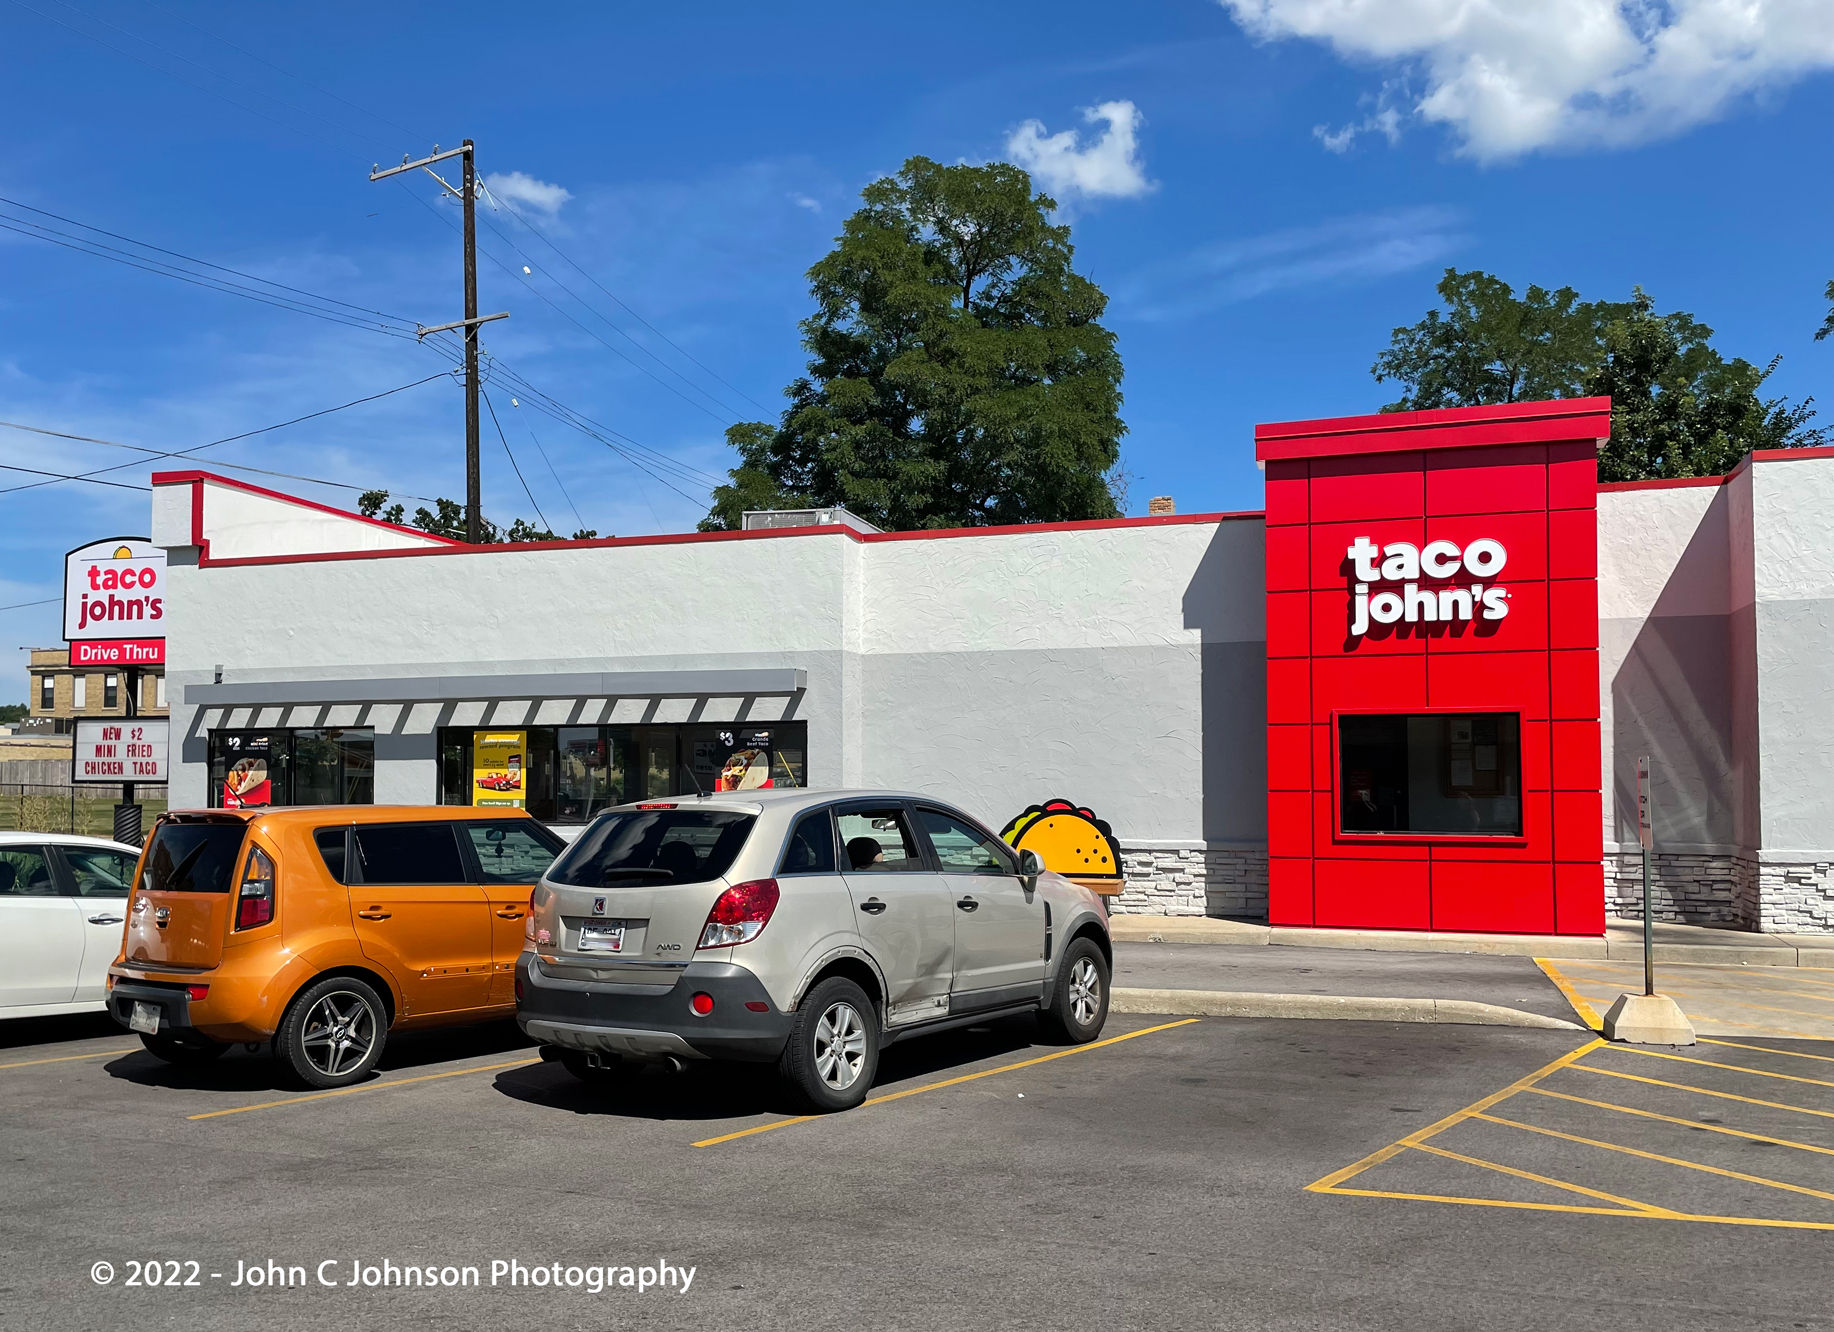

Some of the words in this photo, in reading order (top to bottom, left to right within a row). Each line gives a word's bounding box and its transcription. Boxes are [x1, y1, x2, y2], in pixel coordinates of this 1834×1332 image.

[1347, 536, 1507, 582] taco
[87, 564, 157, 591] taco
[78, 593, 163, 630] john's
[1351, 582, 1510, 636] john's
[80, 645, 119, 661] Drive
[123, 644, 159, 660] Thru
[102, 726, 122, 741] NEW
[131, 727, 143, 741] $2
[720, 732, 734, 746] $3
[95, 744, 117, 758] MINI
[126, 744, 153, 758] FRIED
[228, 737, 240, 750] $2
[84, 761, 124, 775] CHICKEN
[132, 761, 157, 775] TACO
[656, 943, 682, 951] AWD
